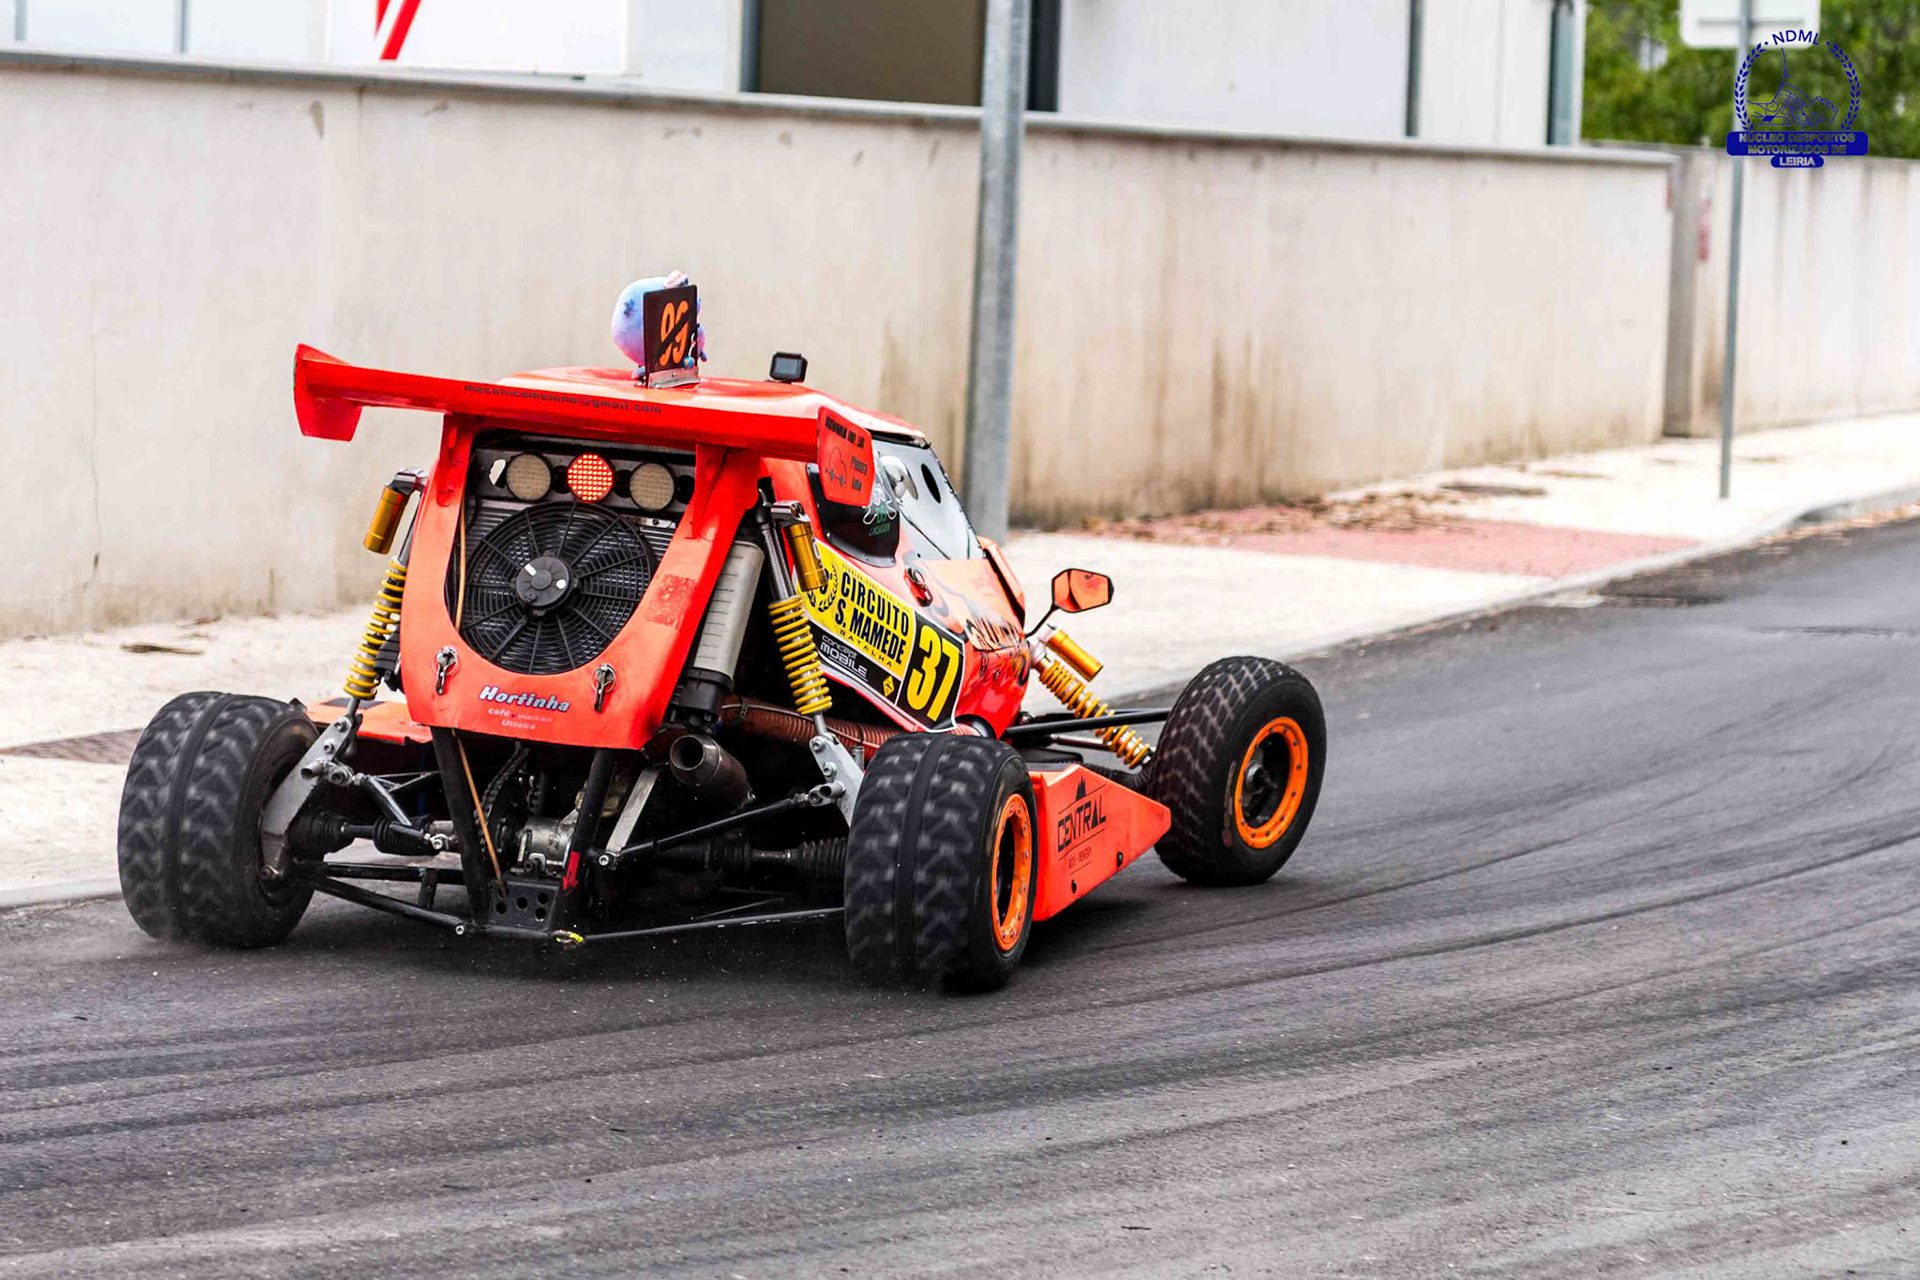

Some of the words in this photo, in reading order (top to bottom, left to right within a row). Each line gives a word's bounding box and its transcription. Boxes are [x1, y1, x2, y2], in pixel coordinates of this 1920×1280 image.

[835, 598, 847, 628] S.
[849, 607, 907, 665] MAMEDE
[840, 571, 910, 637] CIRCUITO
[839, 629, 893, 668] BATALHA
[906, 625, 959, 722] 37
[478, 685, 571, 713] Hortinha
[488, 707, 511, 717] café
[1058, 794, 1106, 853] CENTRAL
